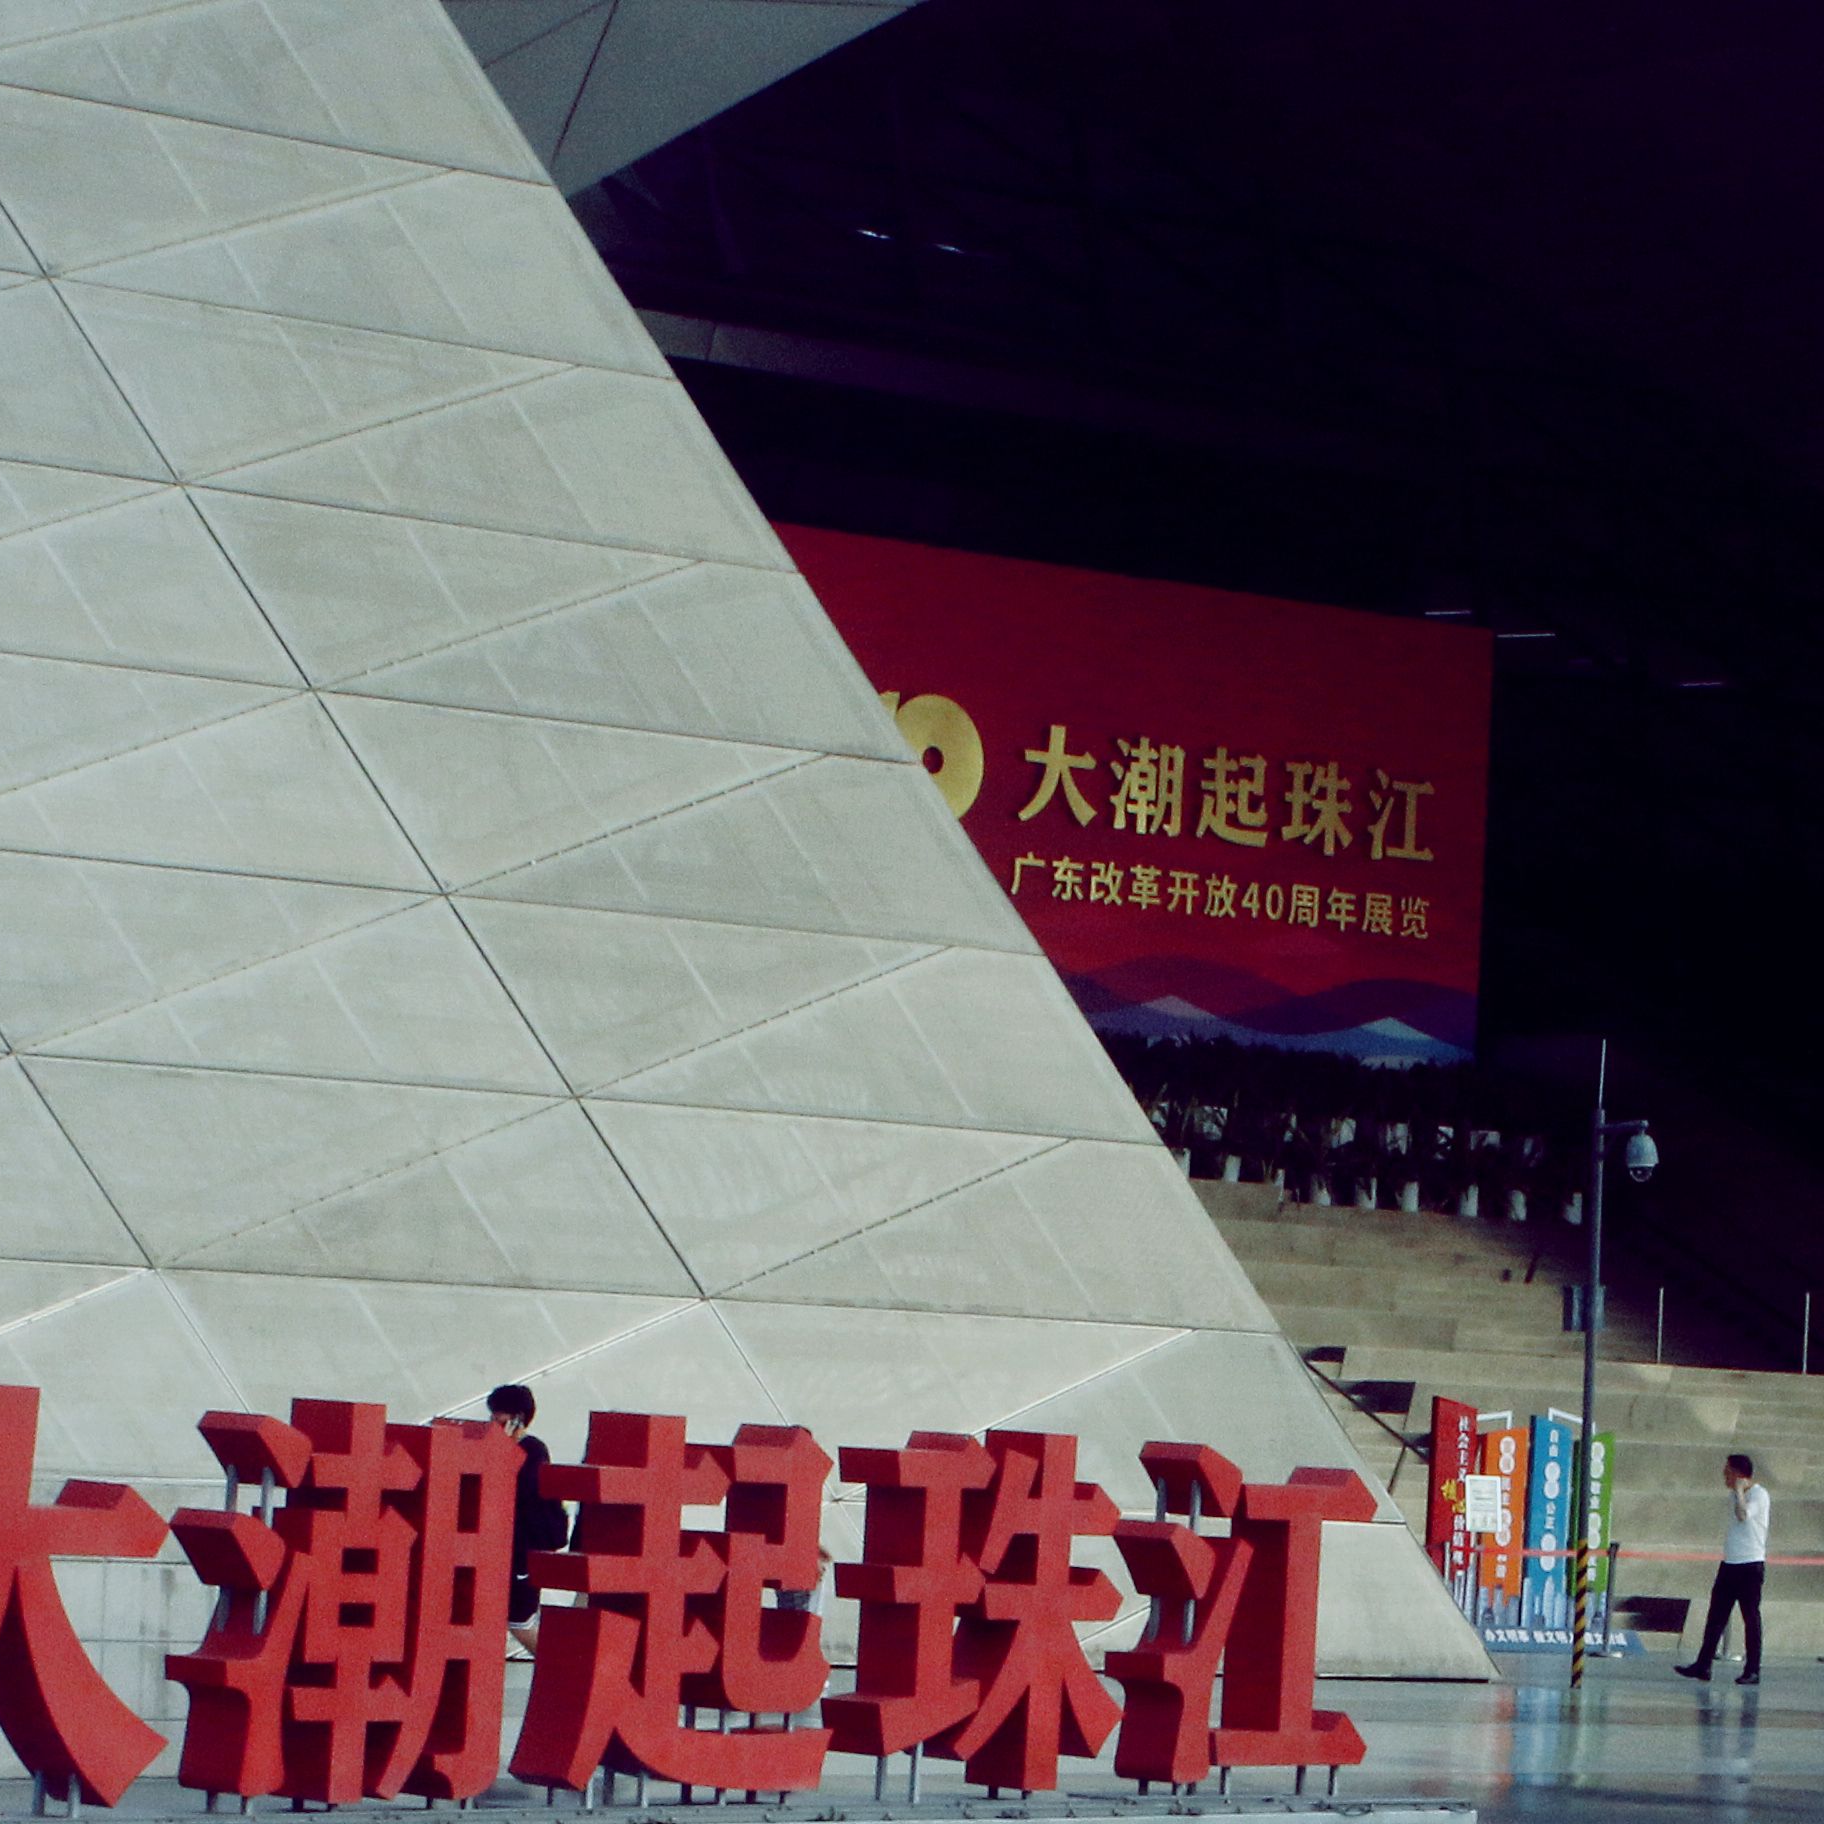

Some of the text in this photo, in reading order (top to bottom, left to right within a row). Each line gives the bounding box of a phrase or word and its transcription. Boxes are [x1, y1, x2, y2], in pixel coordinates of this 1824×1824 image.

[1017, 724, 1436, 864] 大潮起珠江
[1010, 852, 1431, 941] 广东改革开放40周年展览
